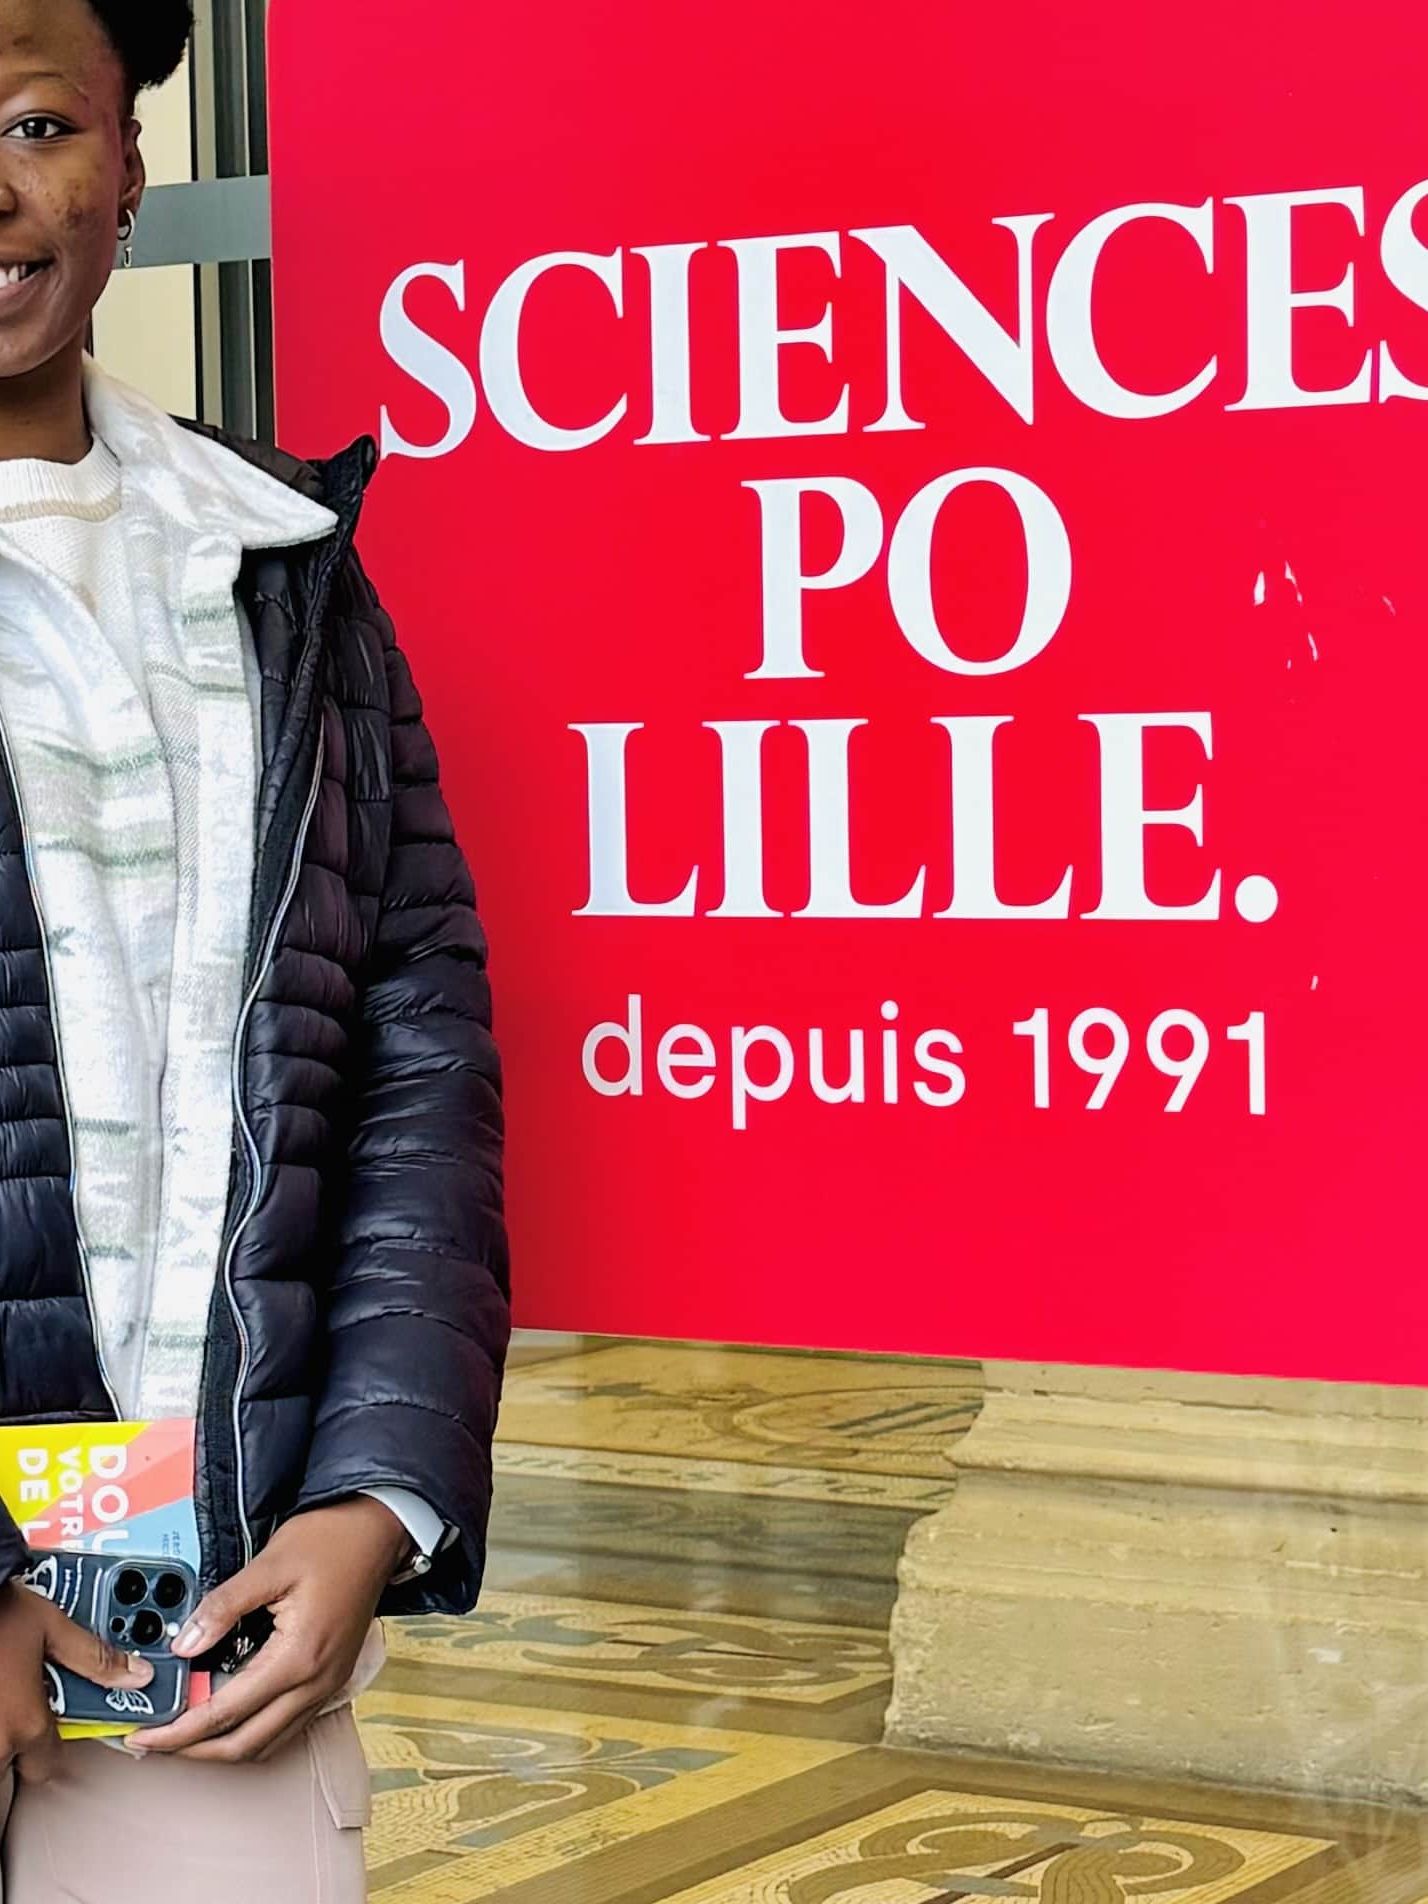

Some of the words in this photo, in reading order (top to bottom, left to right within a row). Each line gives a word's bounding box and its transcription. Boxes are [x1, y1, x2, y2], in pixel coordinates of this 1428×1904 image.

[739, 465, 1073, 681] PO
[566, 710, 1280, 924] LILLE.
[581, 992, 967, 1131] depuis
[1012, 1006, 1267, 1117] 1991
[18, 1449, 51, 1502] DE
